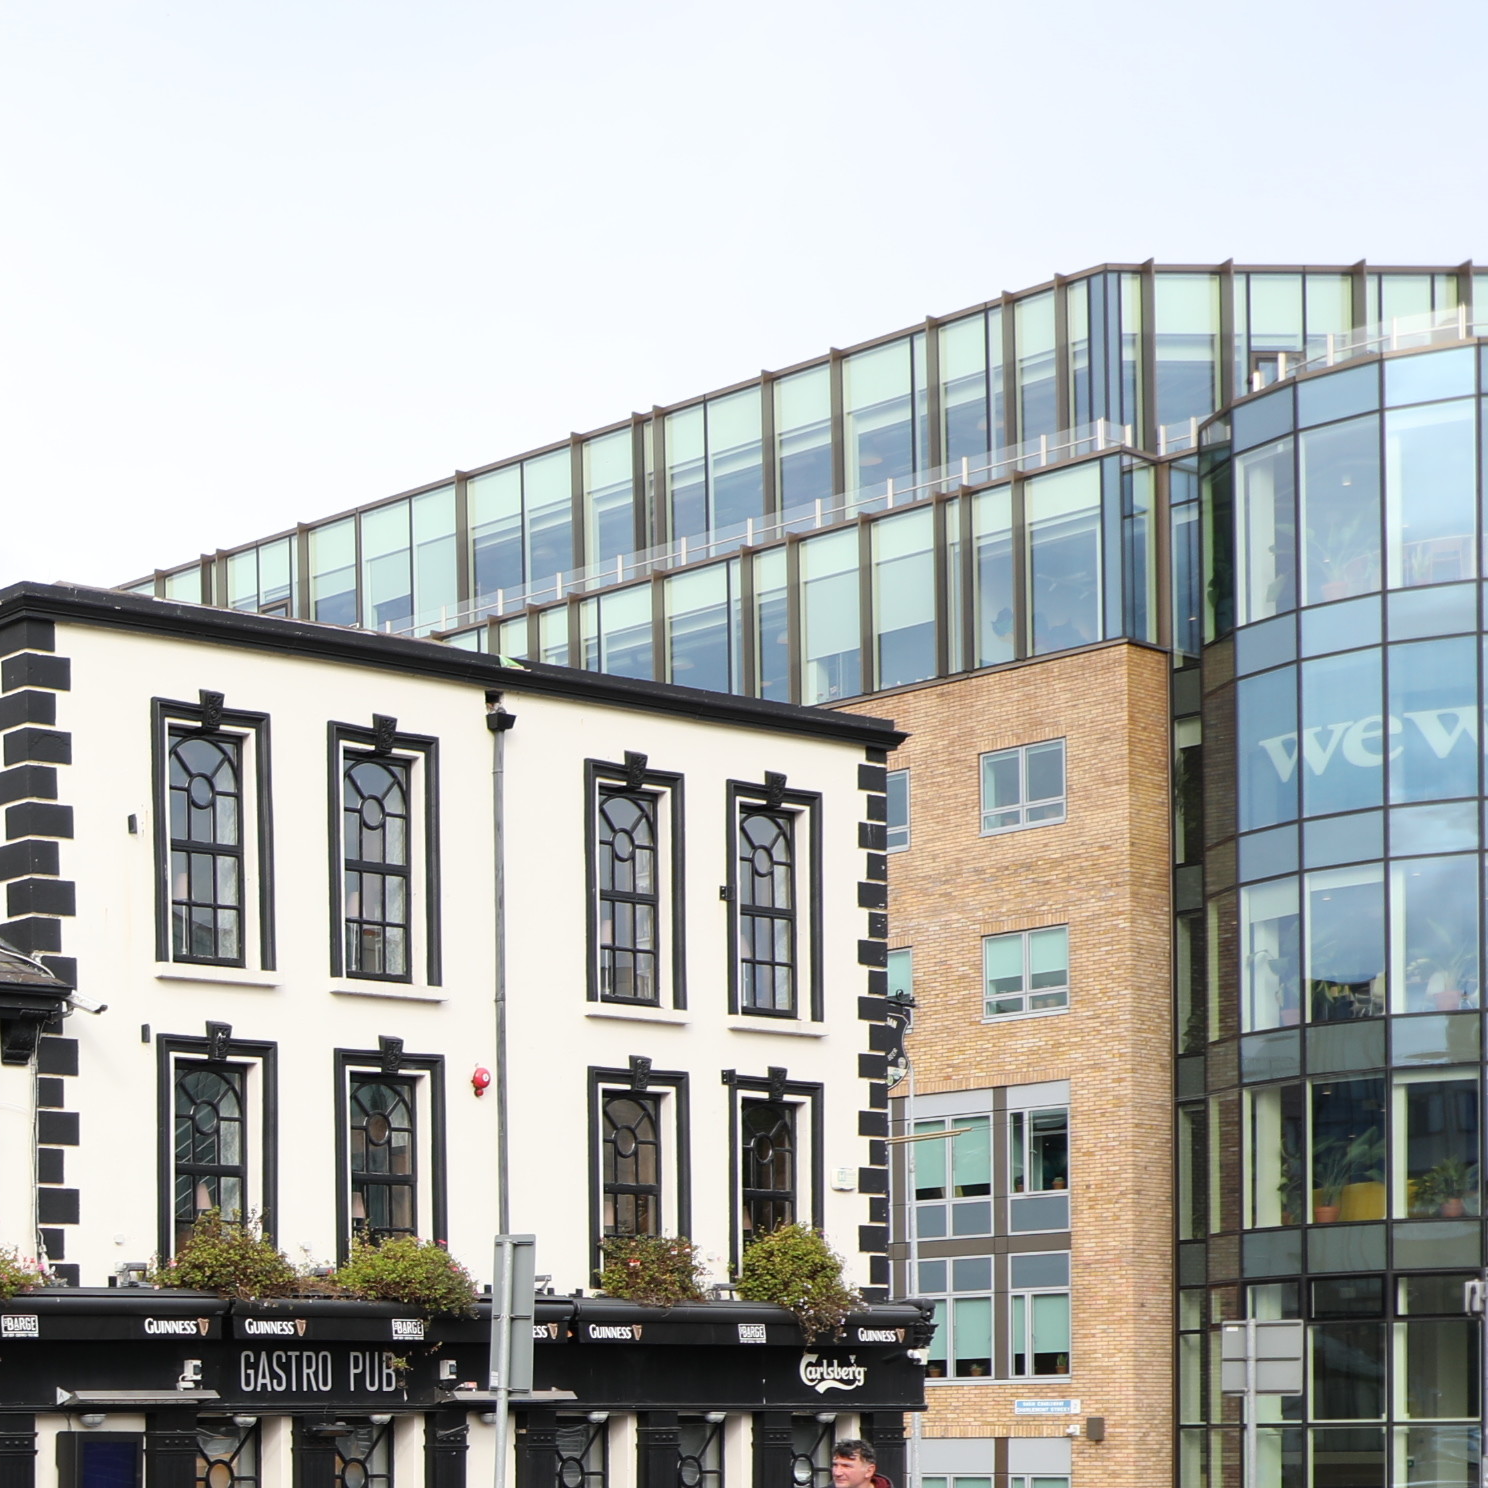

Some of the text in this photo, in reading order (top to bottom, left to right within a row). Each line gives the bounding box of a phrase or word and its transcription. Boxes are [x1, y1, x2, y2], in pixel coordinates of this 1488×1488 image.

[7, 1317, 36, 1331] BARGE
[144, 1318, 197, 1335] GUINNESS
[245, 1318, 295, 1335] GUINNESS
[397, 1321, 422, 1335] BARGE
[589, 1324, 632, 1339] GUINNESS
[858, 1327, 897, 1342] GUINNESS
[240, 1351, 397, 1392] GASTRO PUB
[799, 1354, 867, 1394] Carlsberg
